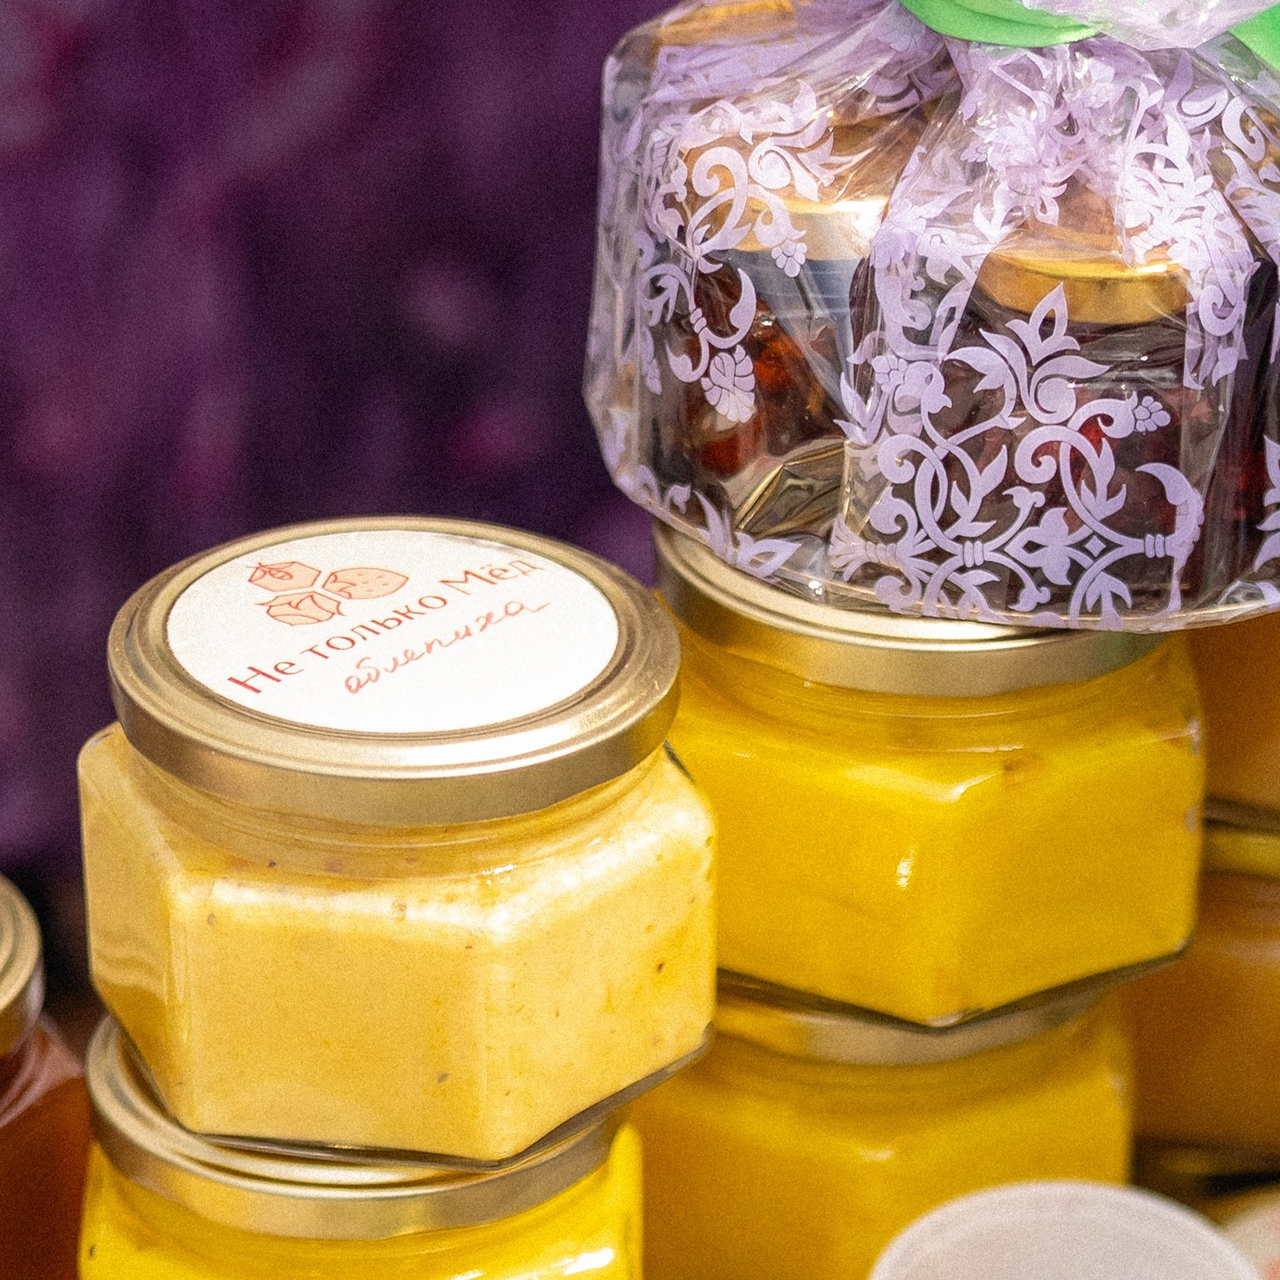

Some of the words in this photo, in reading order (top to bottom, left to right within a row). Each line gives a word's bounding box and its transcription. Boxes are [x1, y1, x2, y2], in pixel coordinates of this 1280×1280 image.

[227, 660, 304, 694] Не
[301, 595, 447, 659] только
[439, 559, 545, 595] Мёд
